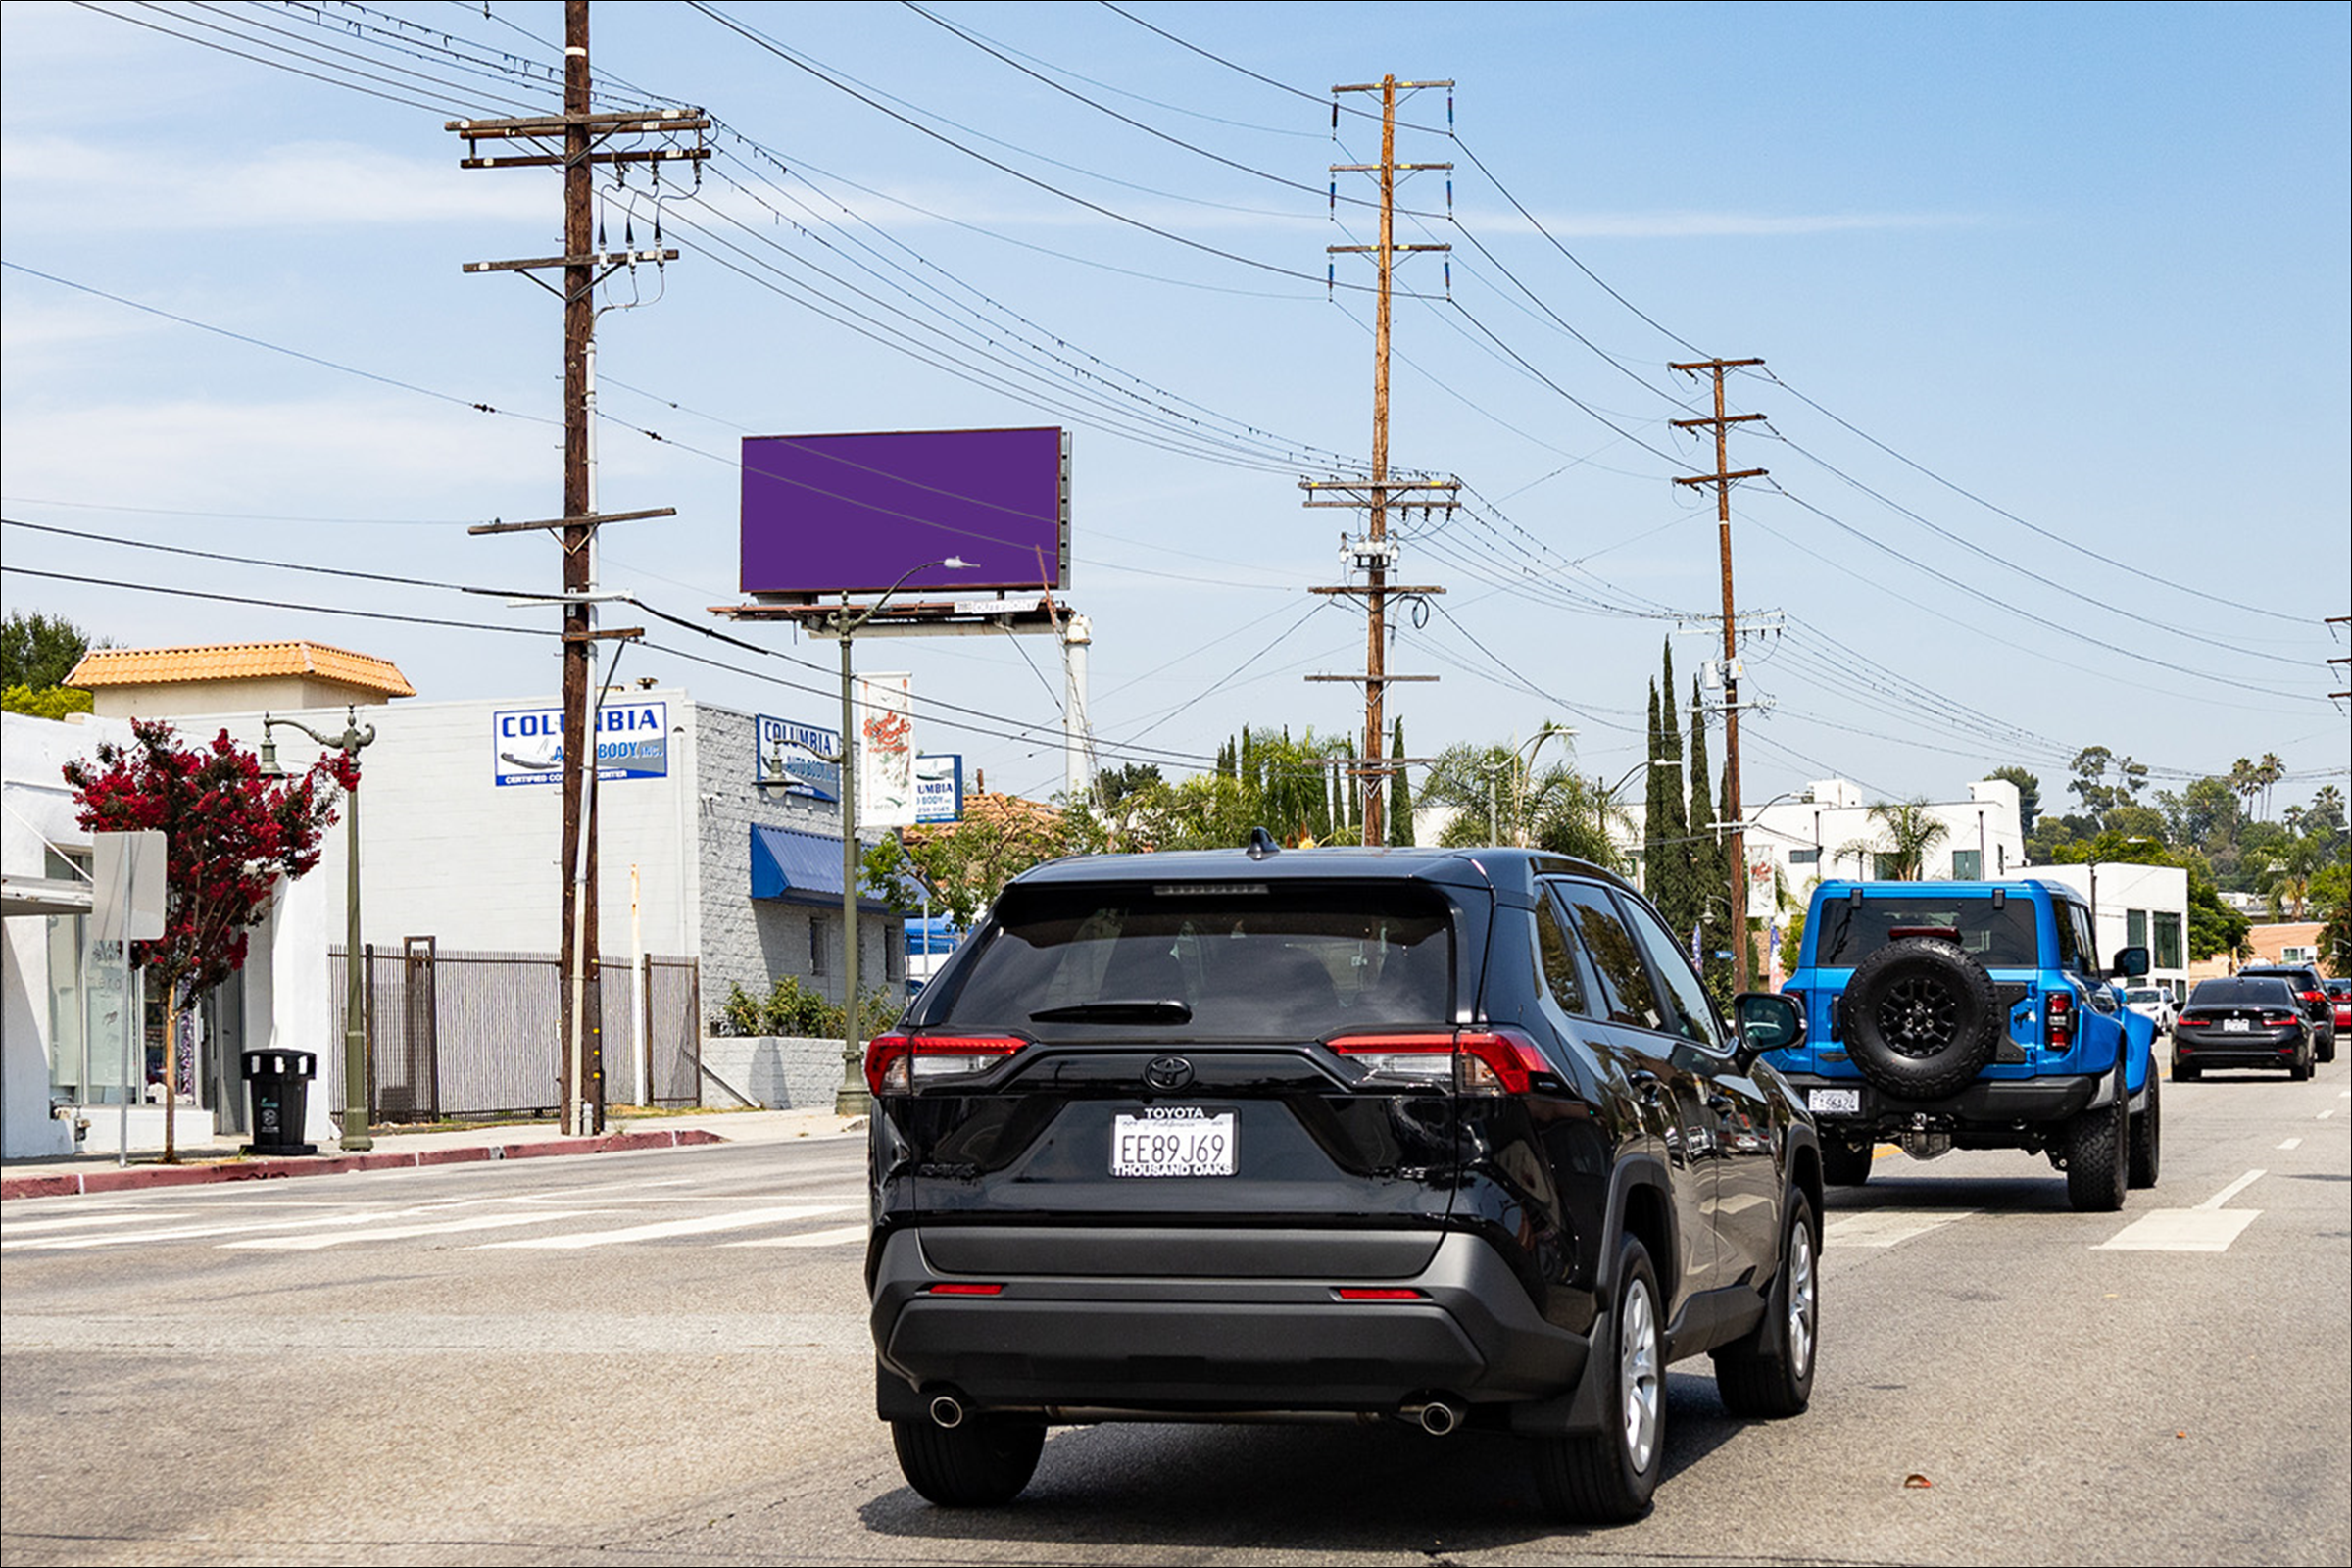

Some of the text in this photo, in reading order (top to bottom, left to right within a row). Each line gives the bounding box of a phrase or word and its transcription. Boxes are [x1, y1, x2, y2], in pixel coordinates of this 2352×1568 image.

[502, 709, 658, 738] COLBIA
[764, 721, 832, 755] COLUMBIA
[917, 783, 953, 794] UMBIA
[1144, 1107, 1204, 1119] TOYOTA
[1122, 1134, 1224, 1163] EE89J69
[1113, 1163, 1233, 1176] THOUSAND OAKS
